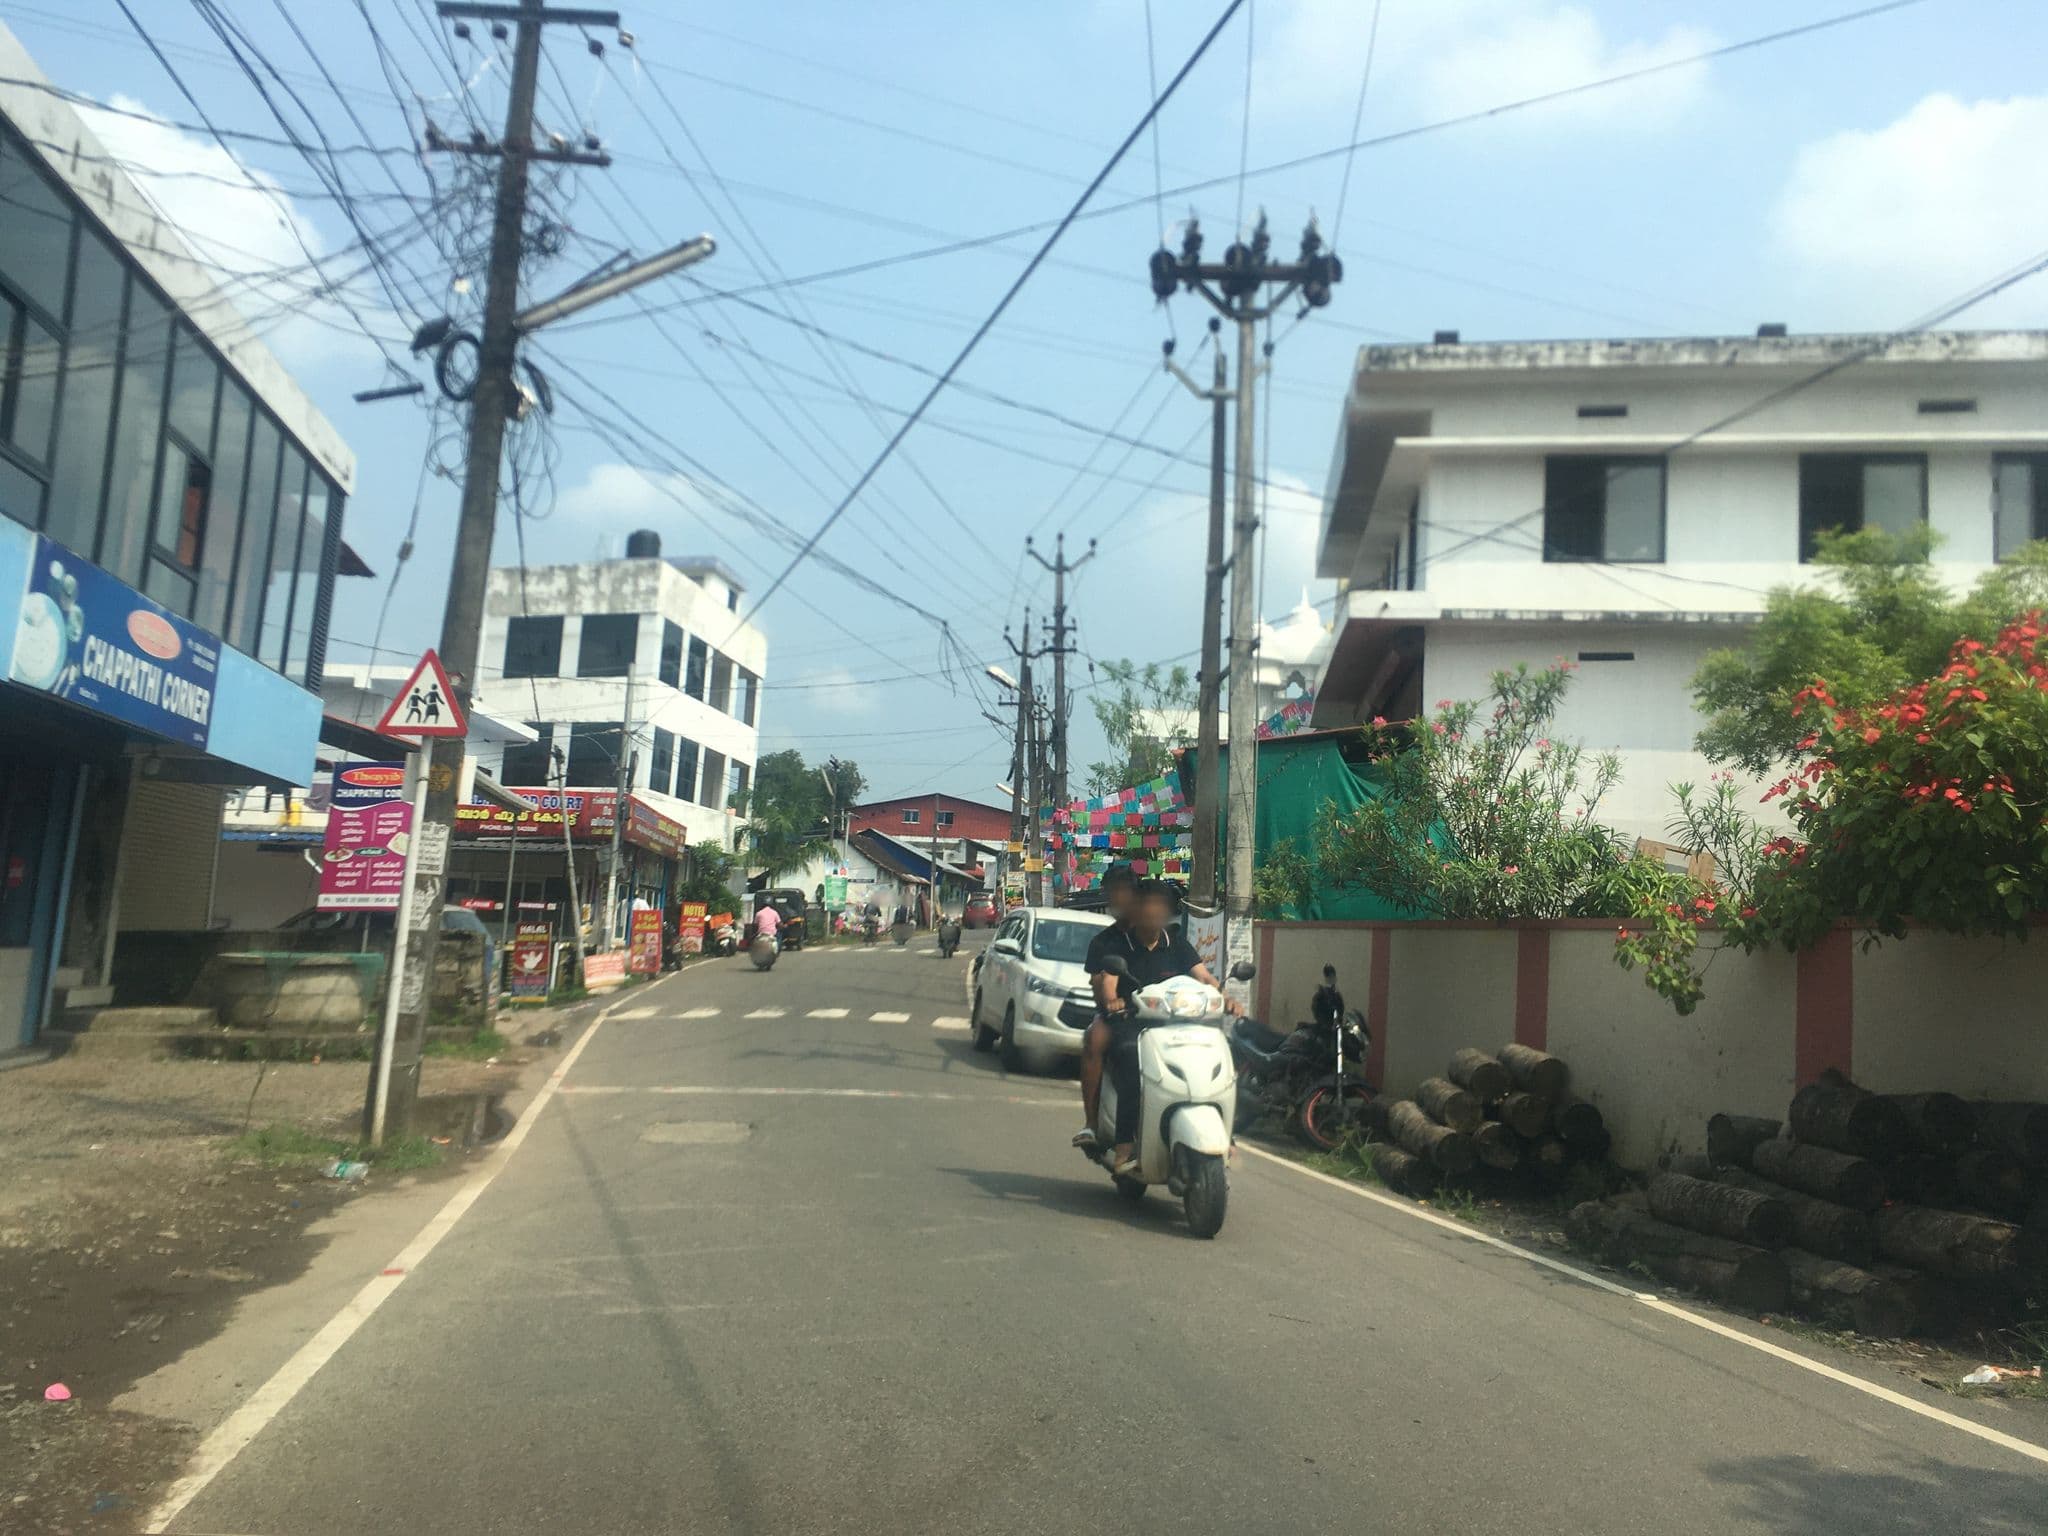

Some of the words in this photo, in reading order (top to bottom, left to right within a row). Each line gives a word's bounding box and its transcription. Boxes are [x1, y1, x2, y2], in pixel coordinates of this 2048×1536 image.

[84, 636, 162, 705] CHAPPATHI
[162, 672, 211, 726] CORNER
[541, 795, 584, 810] CORT
